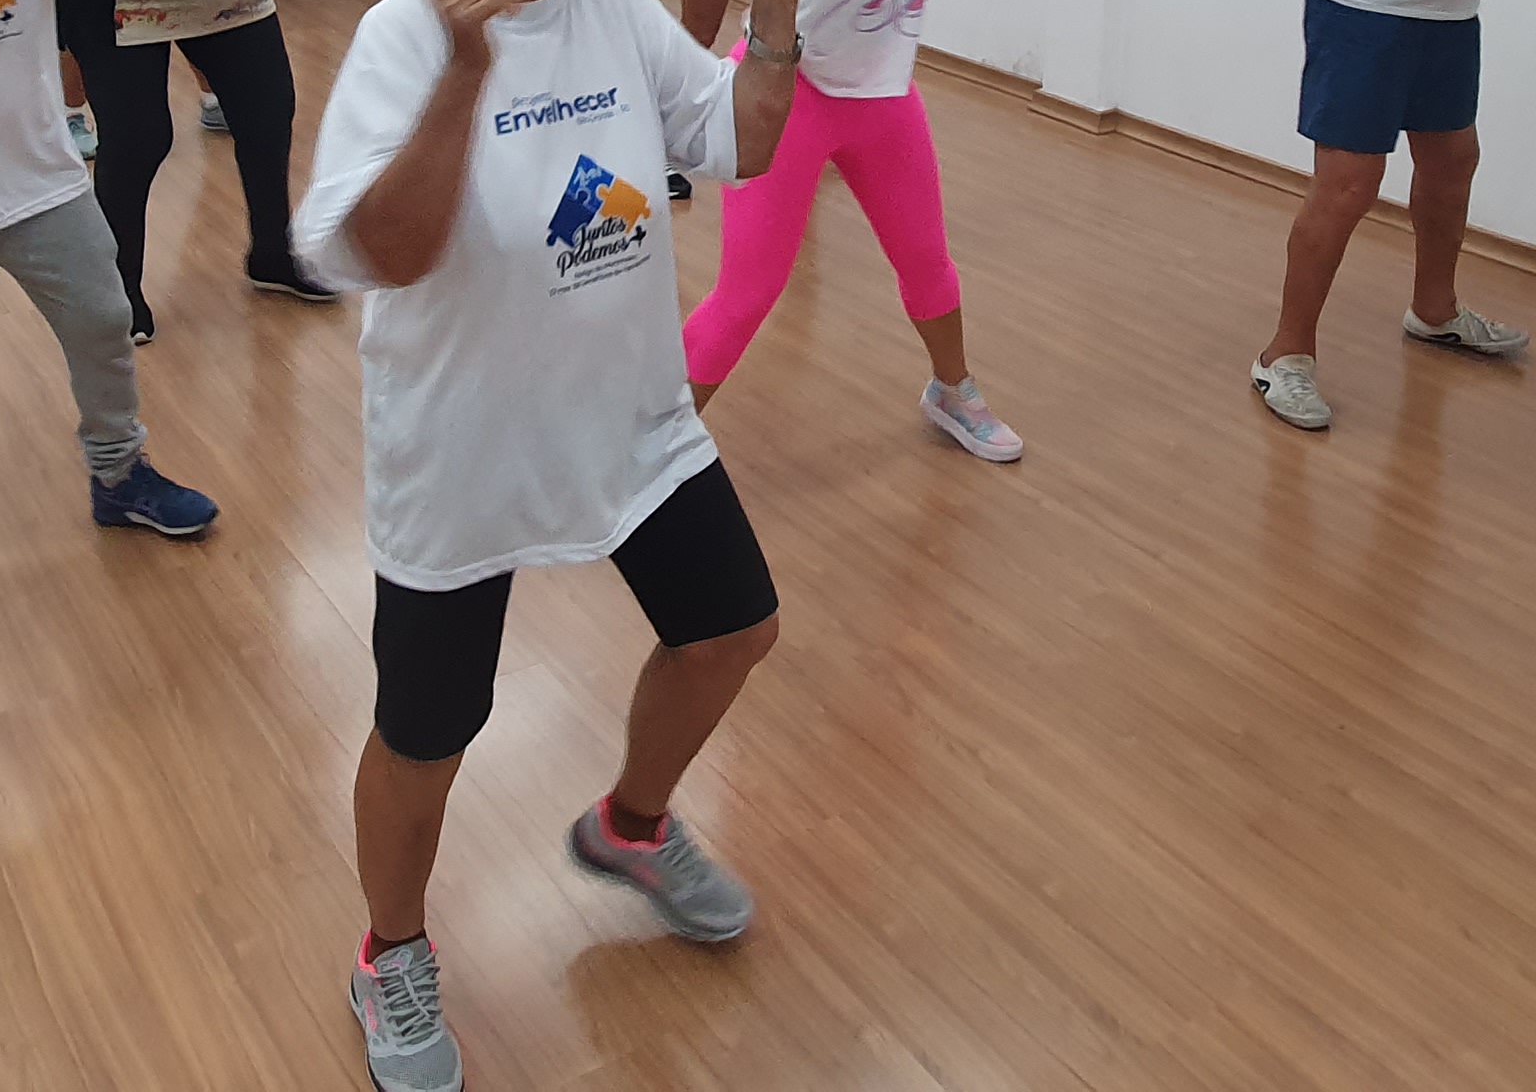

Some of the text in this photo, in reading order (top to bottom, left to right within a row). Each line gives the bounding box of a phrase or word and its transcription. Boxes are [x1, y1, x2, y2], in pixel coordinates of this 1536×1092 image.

[494, 87, 619, 135] Envelhecer
[572, 216, 627, 249] Juntos
[556, 236, 630, 278] Podemos
